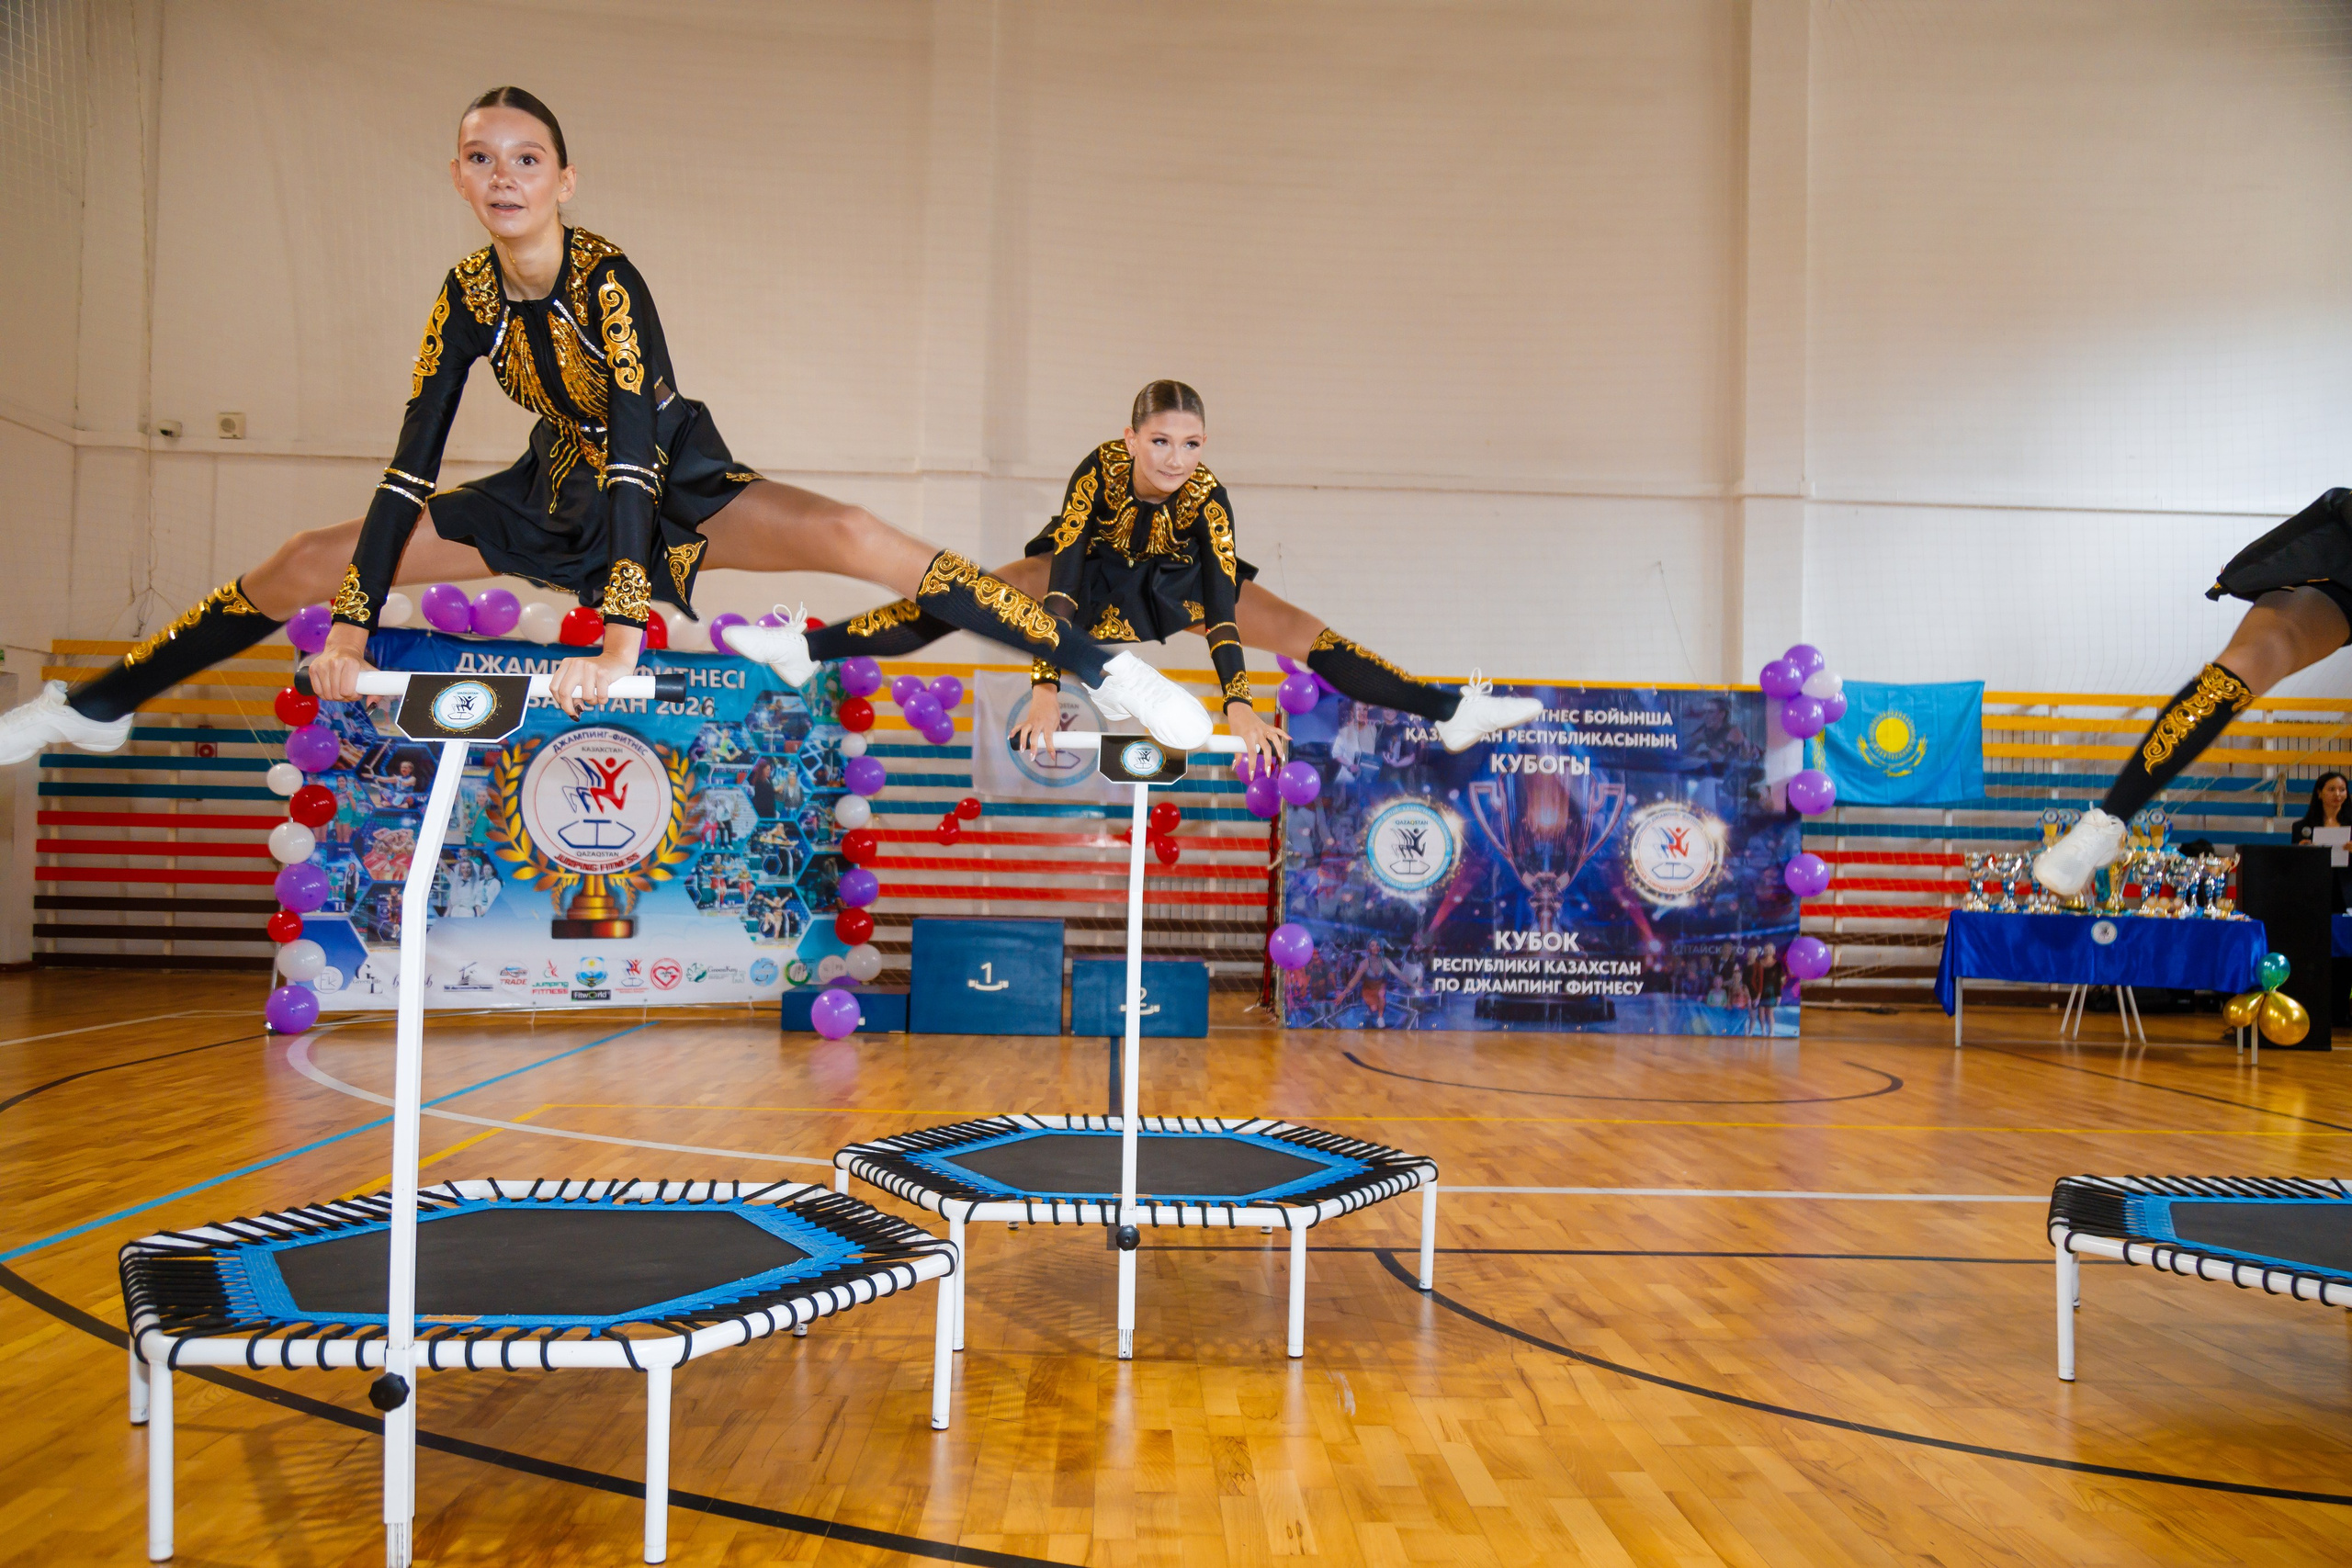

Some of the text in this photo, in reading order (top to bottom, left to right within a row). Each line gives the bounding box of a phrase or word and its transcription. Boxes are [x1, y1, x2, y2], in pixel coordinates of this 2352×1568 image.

[1535, 707, 1674, 726] ТНЕС БОЙЫНША
[1508, 729, 1678, 750] РЕСПУБЛИКАСЫНЫҢ
[1490, 753, 1590, 775] КУБОГЫ
[554, 852, 640, 872] JUMPING FITNESS
[1495, 931, 1580, 952] КУБОК
[980, 962, 992, 984] 1
[1433, 958, 1642, 976] РЕСПУБЛИКИ КАЗАХСТАН
[1434, 977, 1644, 996] ПО ДЖАМПИНГ ФИТНЕСУ
